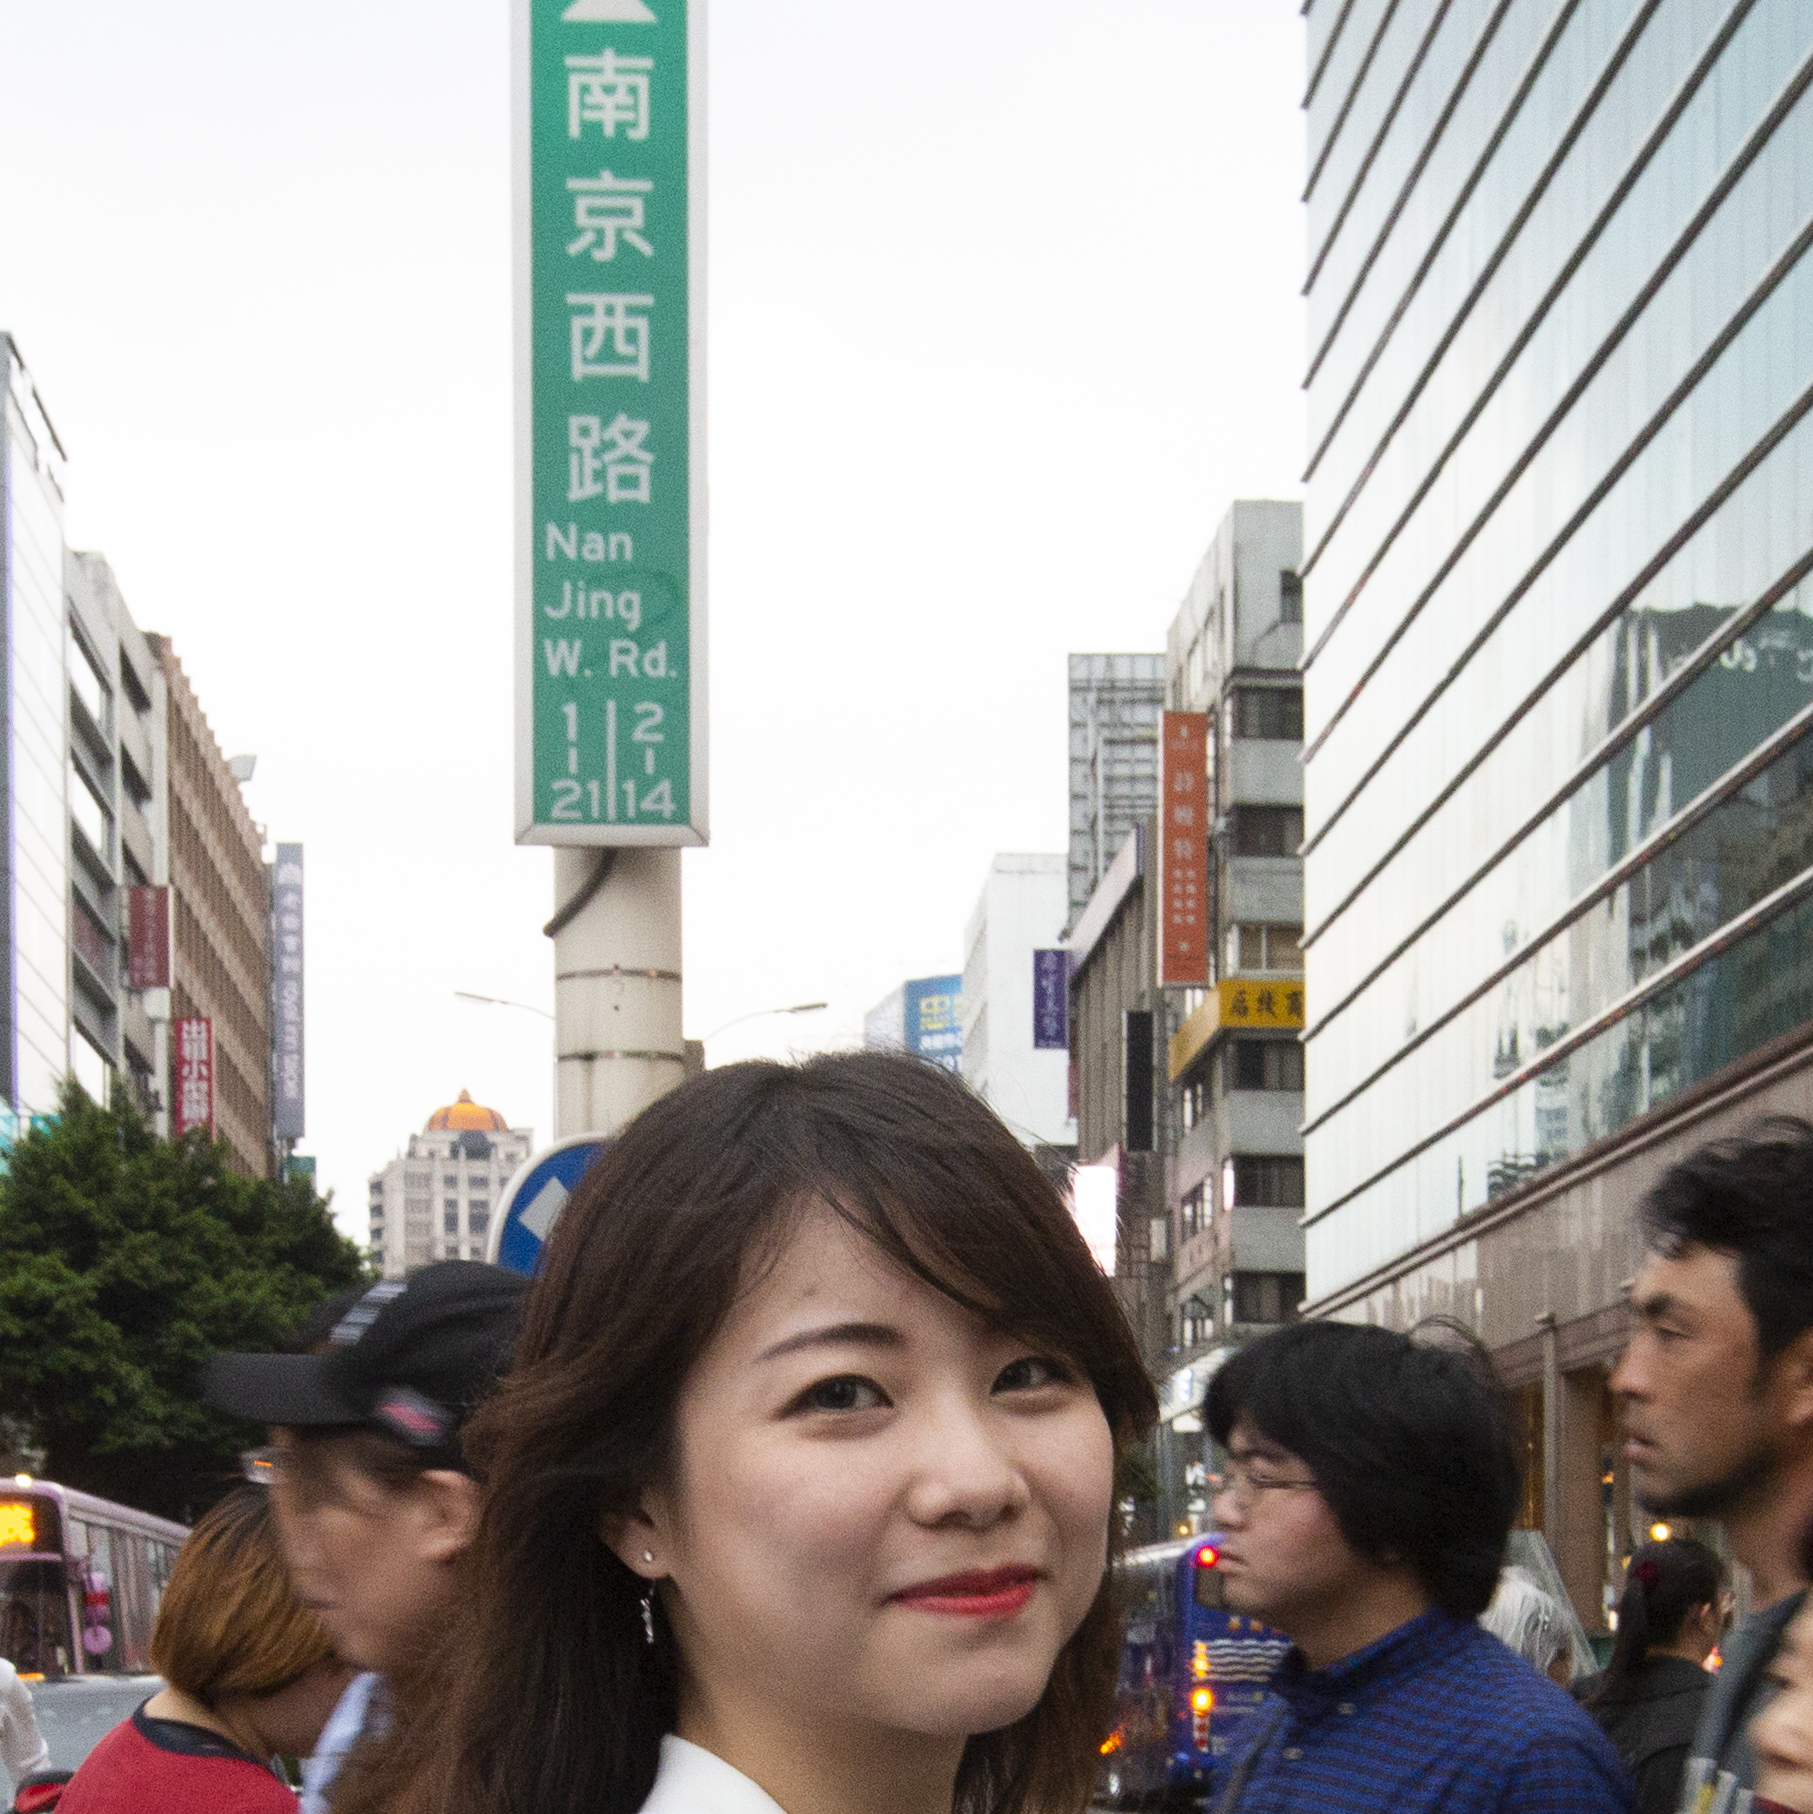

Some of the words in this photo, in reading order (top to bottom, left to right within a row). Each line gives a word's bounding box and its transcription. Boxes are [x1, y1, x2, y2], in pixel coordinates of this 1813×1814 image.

[563, 47, 655, 504] 南京西路
[544, 521, 634, 562] Nan
[543, 580, 643, 633] Jing
[543, 638, 593, 678] W.
[609, 638, 678, 678] Rd.
[631, 701, 666, 743] 2
[550, 778, 600, 820] 21
[621, 778, 677, 819] 14
